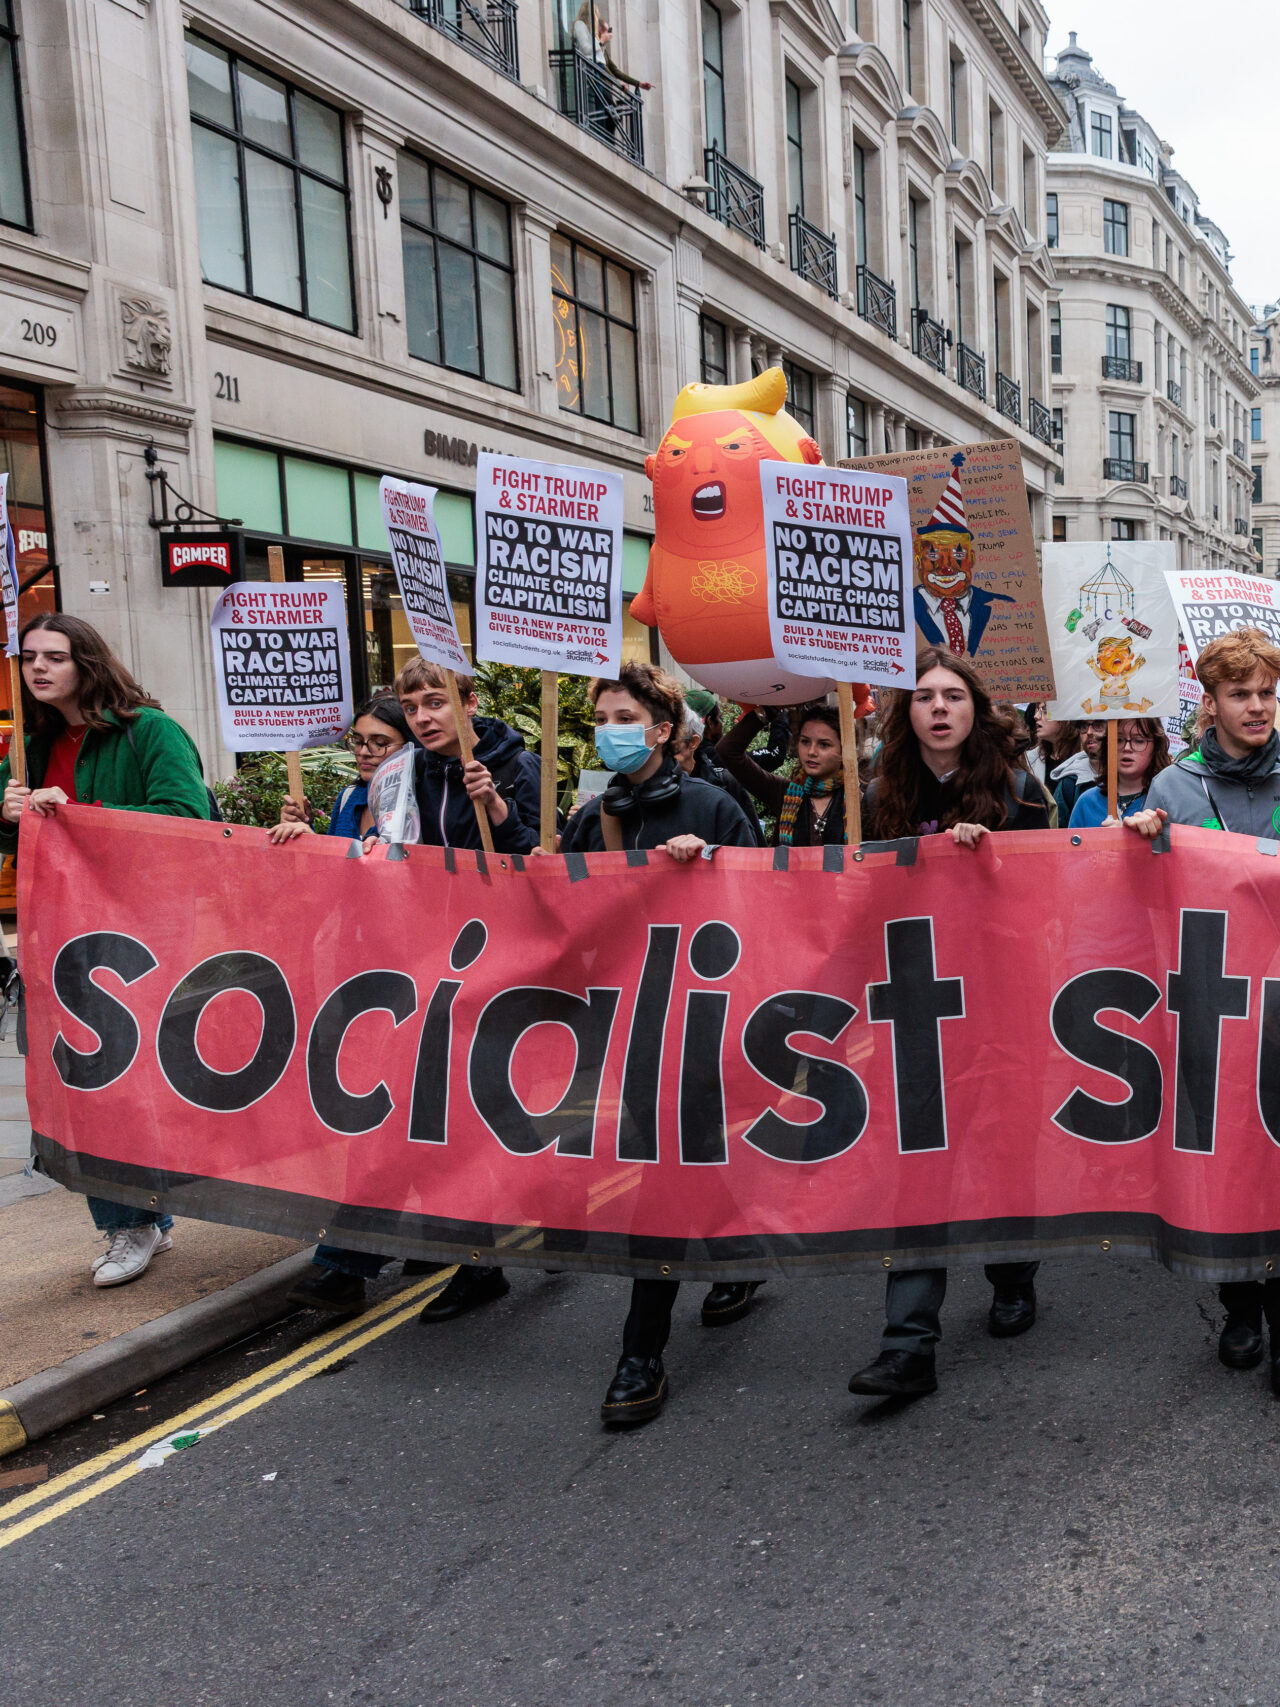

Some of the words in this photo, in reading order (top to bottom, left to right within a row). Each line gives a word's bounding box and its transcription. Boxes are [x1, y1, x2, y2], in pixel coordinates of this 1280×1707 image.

[21, 319, 57, 346] 209
[215, 372, 240, 402] 211
[424, 429, 478, 467] BIMBA
[965, 443, 1014, 455] DISABLED
[840, 462, 874, 470] DONALD
[875, 459, 900, 468] TRUMP
[493, 468, 541, 492] FIGHT
[544, 476, 607, 501] TRUMP
[776, 477, 826, 501] FIGHT
[831, 483, 893, 507] TRUMP
[499, 490, 511, 508] &
[517, 493, 599, 522] STARMER
[786, 500, 798, 518] &
[803, 501, 886, 529] STARMER
[487, 516, 519, 540] NO
[524, 522, 551, 544] TO
[557, 528, 611, 554] WAR
[775, 527, 807, 549] NO
[812, 532, 840, 554] TO
[847, 536, 900, 561] WAR
[172, 546, 227, 567] CAMPER
[489, 539, 608, 583] RACISM
[488, 569, 550, 592] CLIMATE
[553, 580, 605, 599] CHAOS
[779, 550, 899, 591] RACISM
[223, 593, 267, 607] FIGHT
[271, 592, 328, 607] TRUMP
[488, 586, 605, 619] CAPITALISM
[779, 581, 842, 601] CLIMATE
[846, 589, 898, 608] CHAOS
[231, 609, 244, 624] &
[248, 609, 323, 624] STARMER
[491, 612, 519, 624] BUILD
[522, 618, 529, 626] A
[532, 619, 554, 629] NEW
[557, 623, 590, 634] PARTY
[593, 628, 605, 636] TO
[780, 598, 899, 628] CAPITALISM
[222, 632, 252, 649] NO
[256, 633, 283, 649] TO
[288, 631, 337, 648] WAR
[489, 622, 512, 633] GIVE
[515, 627, 564, 642] STUDENTS
[567, 635, 573, 643] A
[578, 636, 607, 647] VOICE
[783, 636, 806, 646] GIVE
[809, 638, 859, 652] STUDENTS
[862, 645, 869, 653] A
[871, 646, 902, 657] VOICE
[784, 625, 814, 636] BUILD
[817, 628, 823, 637] A
[826, 630, 848, 641] NEW
[852, 634, 884, 644] PARTY
[886, 637, 900, 646] TO
[226, 650, 337, 673] RACISM
[492, 641, 561, 656] socialiststudents.org.uk
[228, 675, 288, 687] CLIMATE
[290, 673, 338, 686] CHAOS
[230, 686, 339, 703] CAPITALISM
[51, 915, 966, 1167] socialist
